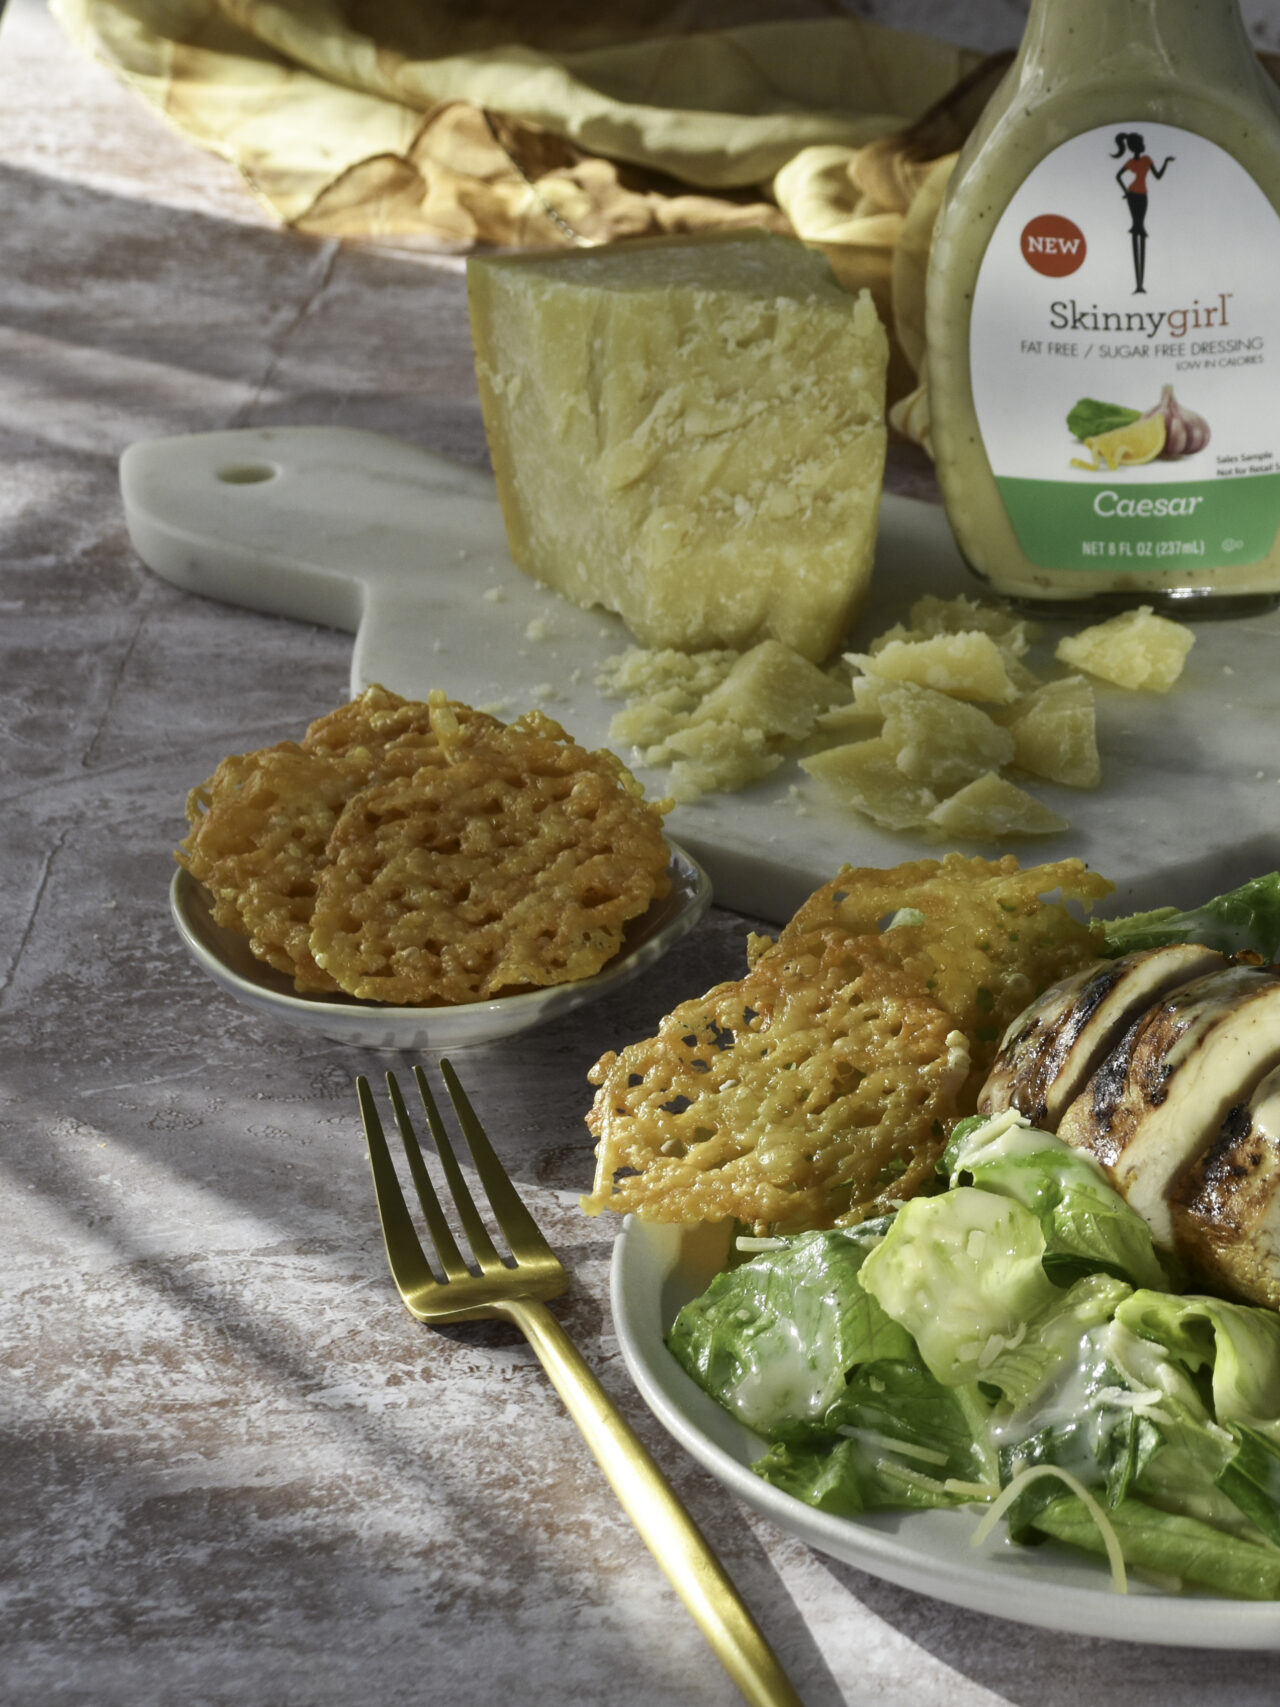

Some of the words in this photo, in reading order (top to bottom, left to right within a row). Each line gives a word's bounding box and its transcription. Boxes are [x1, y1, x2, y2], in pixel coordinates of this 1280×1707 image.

[1028, 235, 1081, 255] NEW
[1050, 293, 1230, 338] Skinnygirl
[1020, 340, 1043, 354] FAT
[1047, 341, 1079, 357] FREE
[1099, 344, 1149, 359] SUGAR
[1154, 343, 1186, 357] FREE
[1191, 336, 1264, 356] DRESSING
[1176, 361, 1200, 371] LOW
[1204, 360, 1216, 369] IN
[1218, 355, 1264, 368] CALORIES
[1093, 490, 1204, 518] Caesar
[1082, 540, 1105, 556] NET
[1108, 541, 1117, 556] 8
[1119, 541, 1133, 556] FL
[1137, 541, 1153, 557] OZ
[1155, 539, 1205, 558] (237mL)
